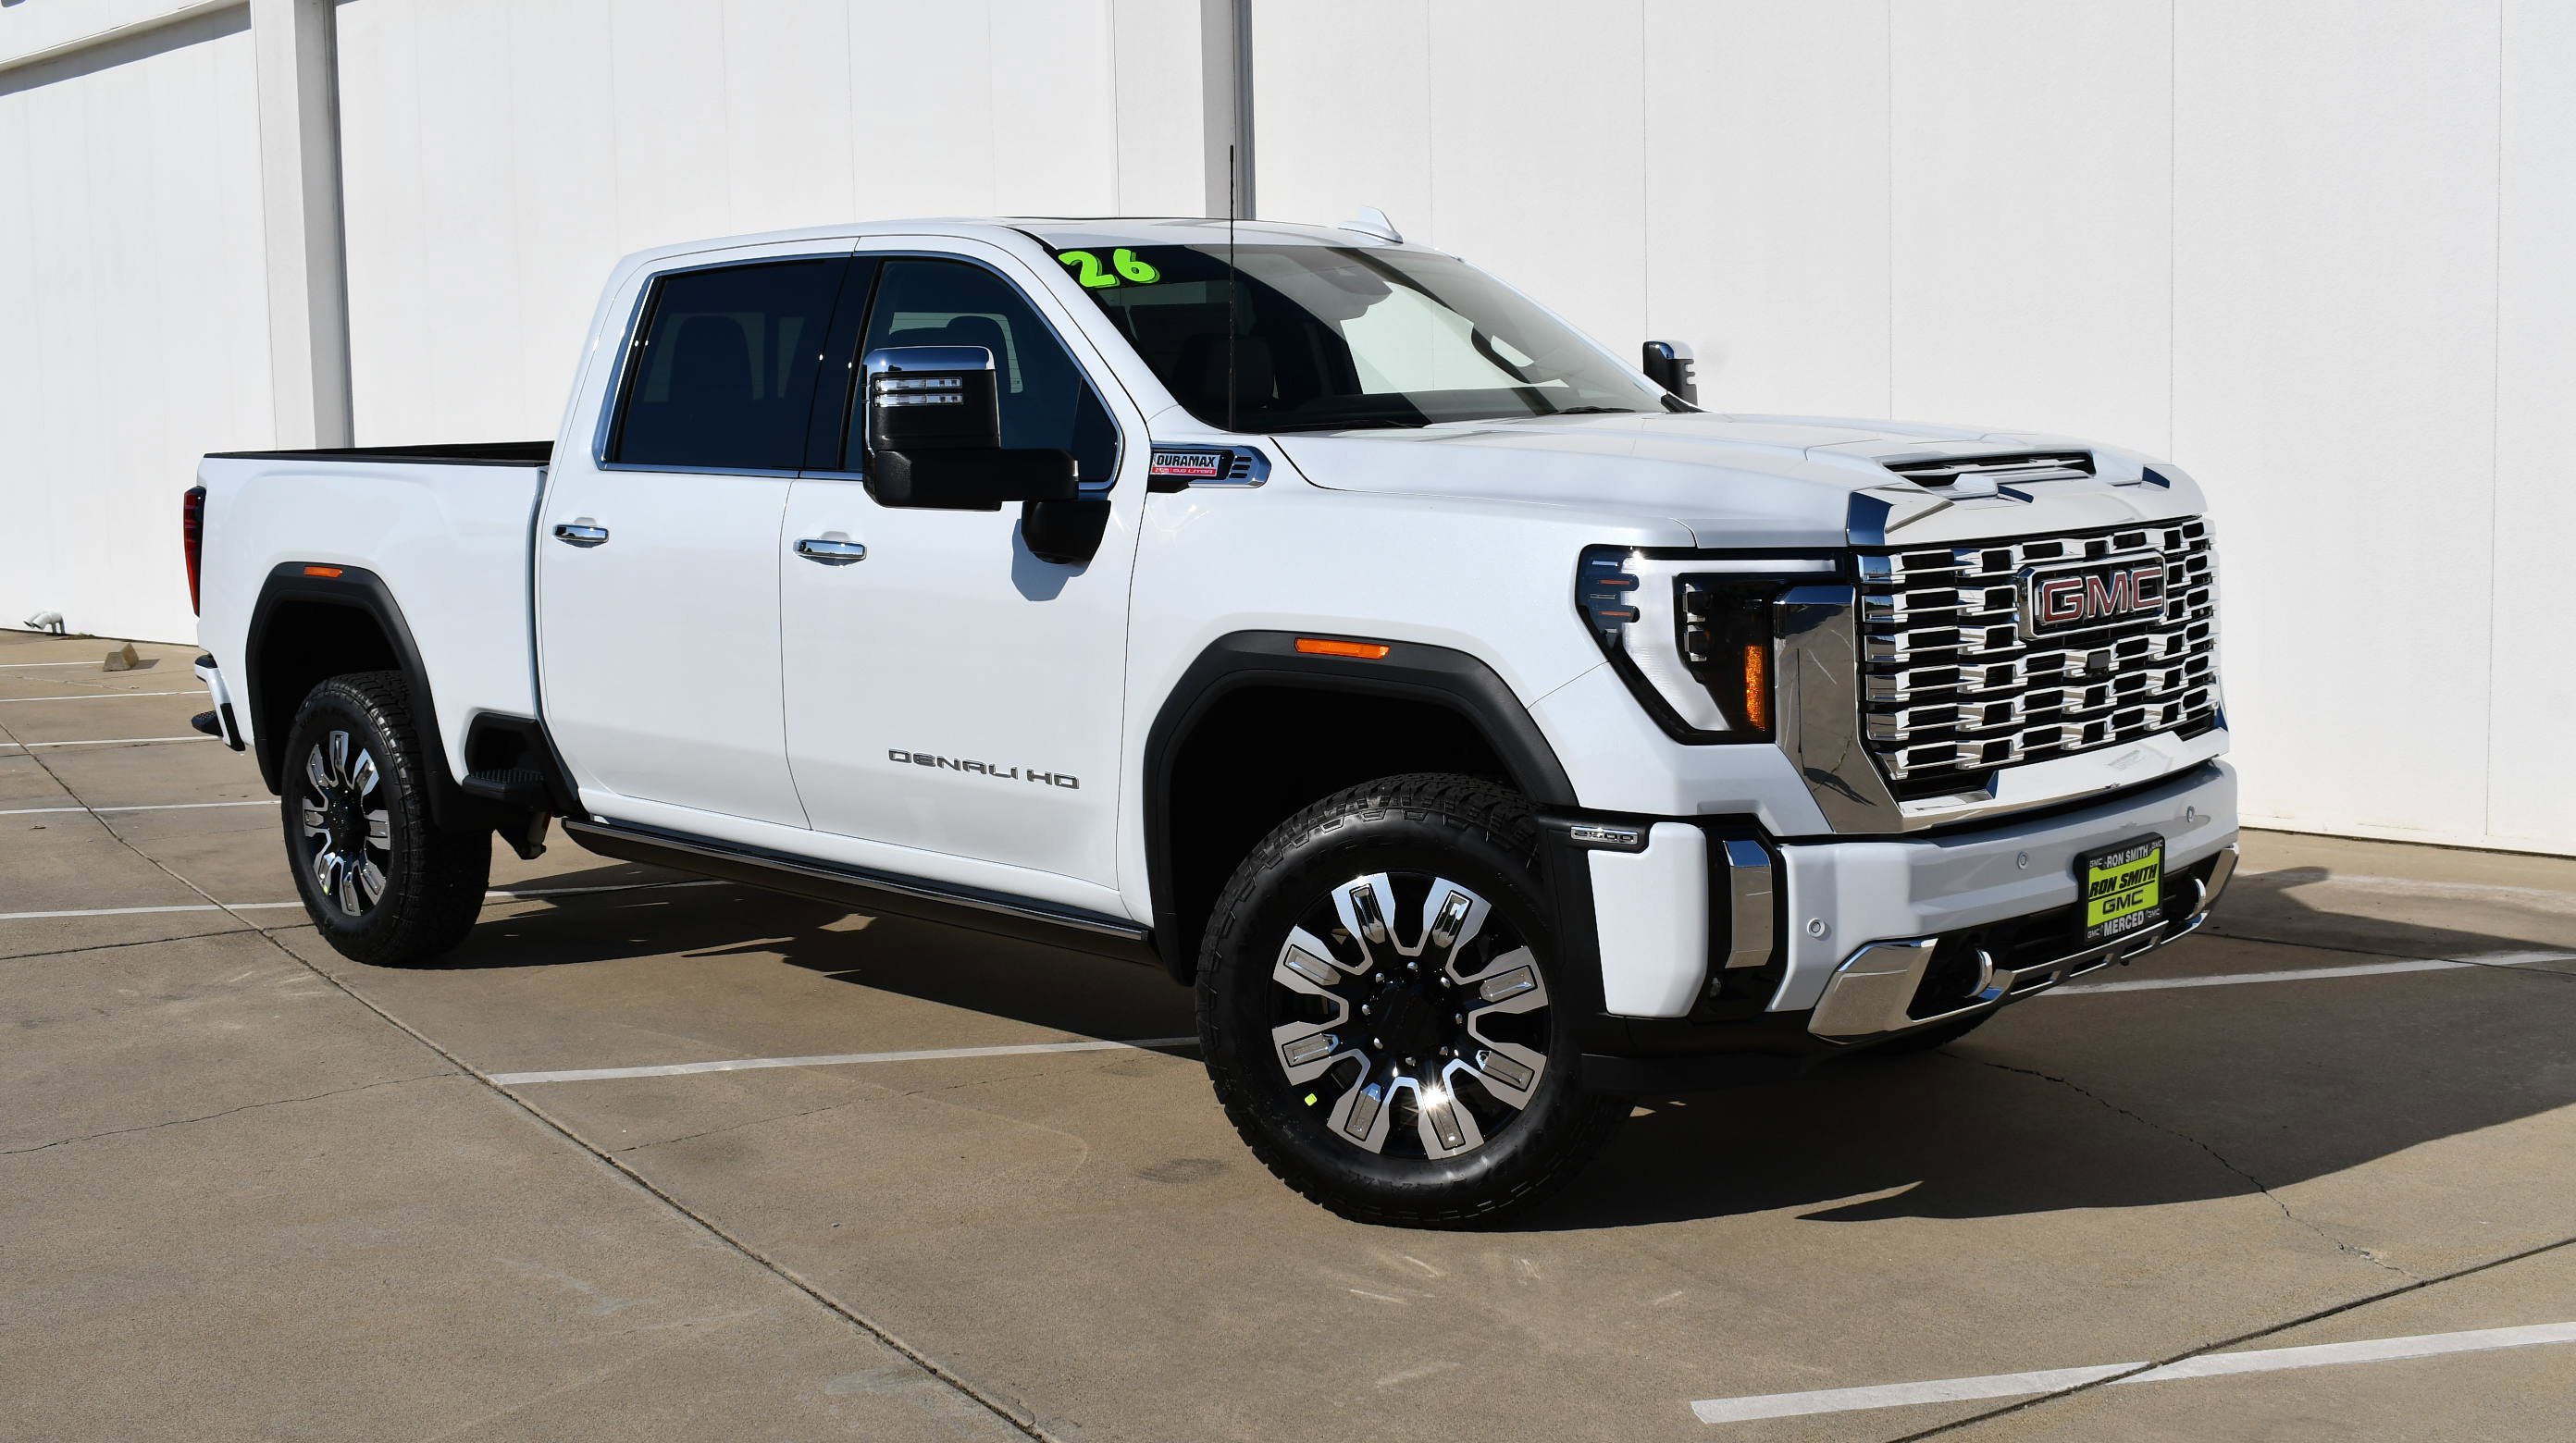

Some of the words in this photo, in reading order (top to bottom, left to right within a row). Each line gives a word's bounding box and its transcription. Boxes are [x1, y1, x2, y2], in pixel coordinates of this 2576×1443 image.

[1058, 248, 1160, 289] 26
[1157, 454, 1216, 467] DURAMAX
[2041, 565, 2163, 623] GMC
[888, 747, 1019, 780] DENALI
[1026, 768, 1080, 790] HD
[2106, 851, 2124, 868] RON
[2125, 844, 2149, 862] SMITH
[2088, 875, 2118, 897] RON
[2119, 864, 2158, 889] SMITH
[2102, 889, 2144, 915] GMC
[2103, 910, 2145, 937] MERCED
